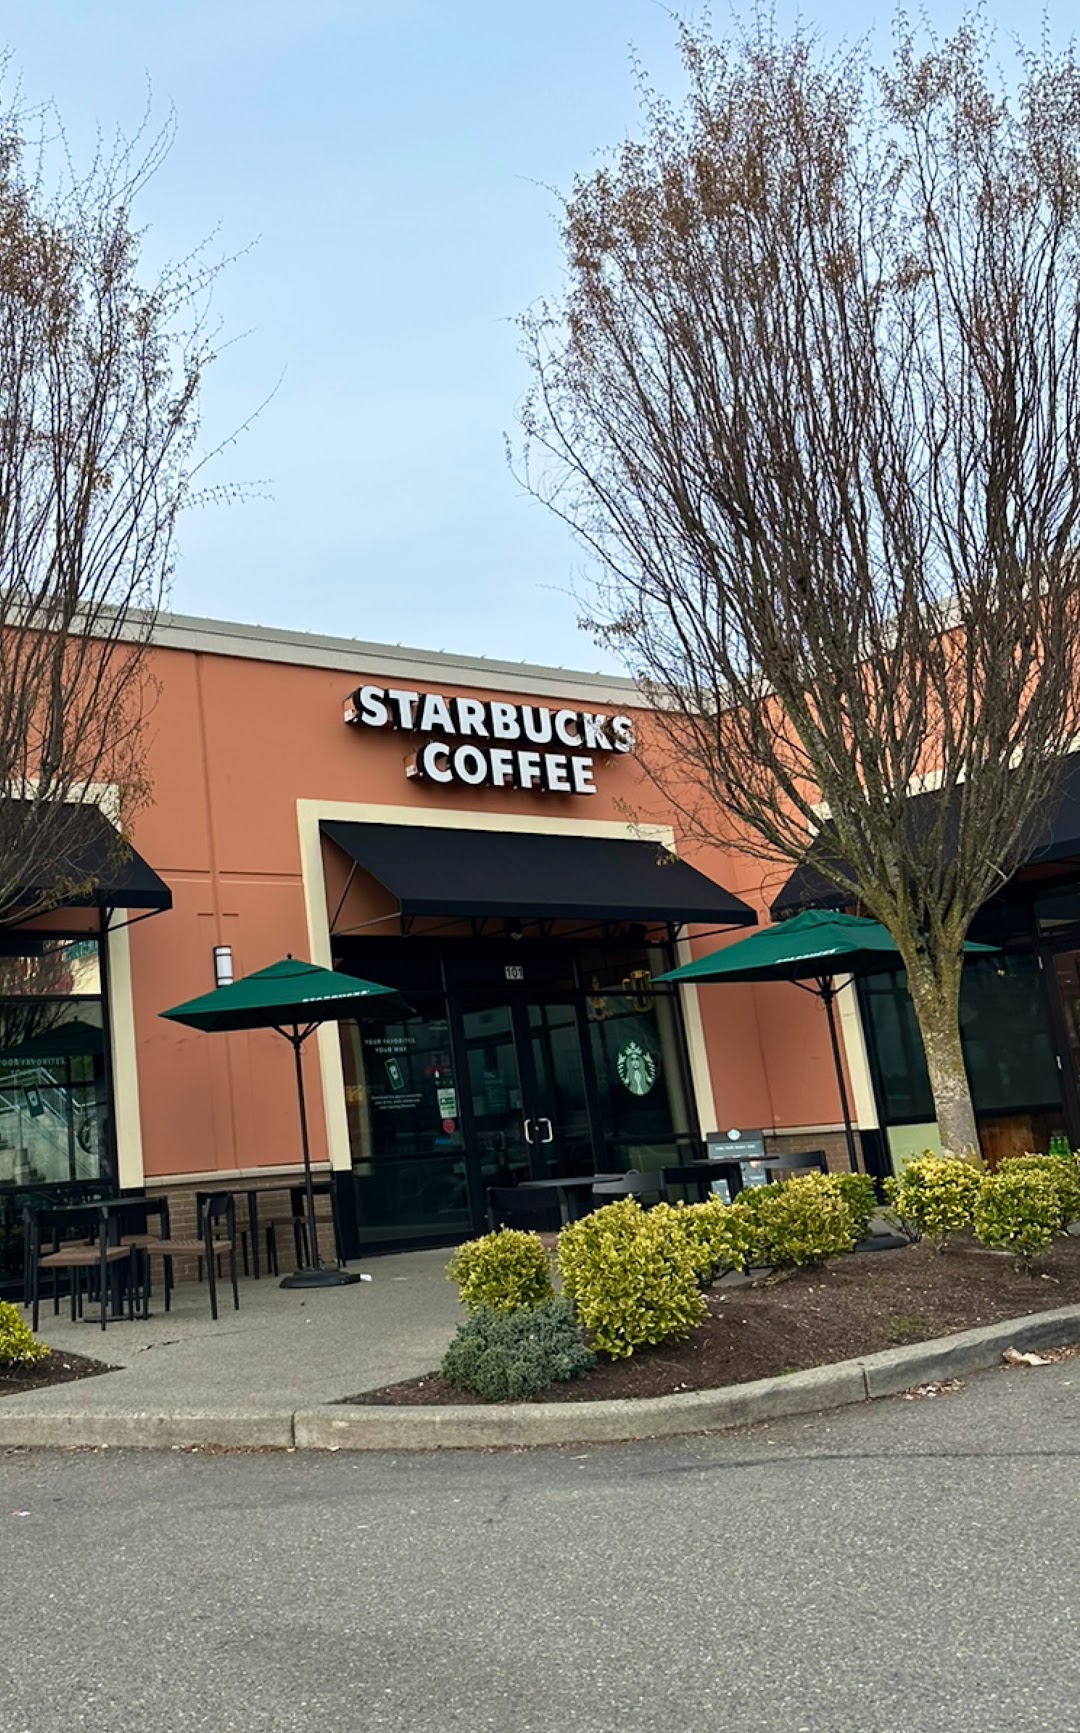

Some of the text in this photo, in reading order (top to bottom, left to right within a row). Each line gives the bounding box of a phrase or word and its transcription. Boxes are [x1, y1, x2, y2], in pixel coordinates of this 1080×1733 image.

[359, 685, 636, 752] STARBUCKS
[423, 742, 597, 794] COFFEE
[505, 965, 523, 979] 101
